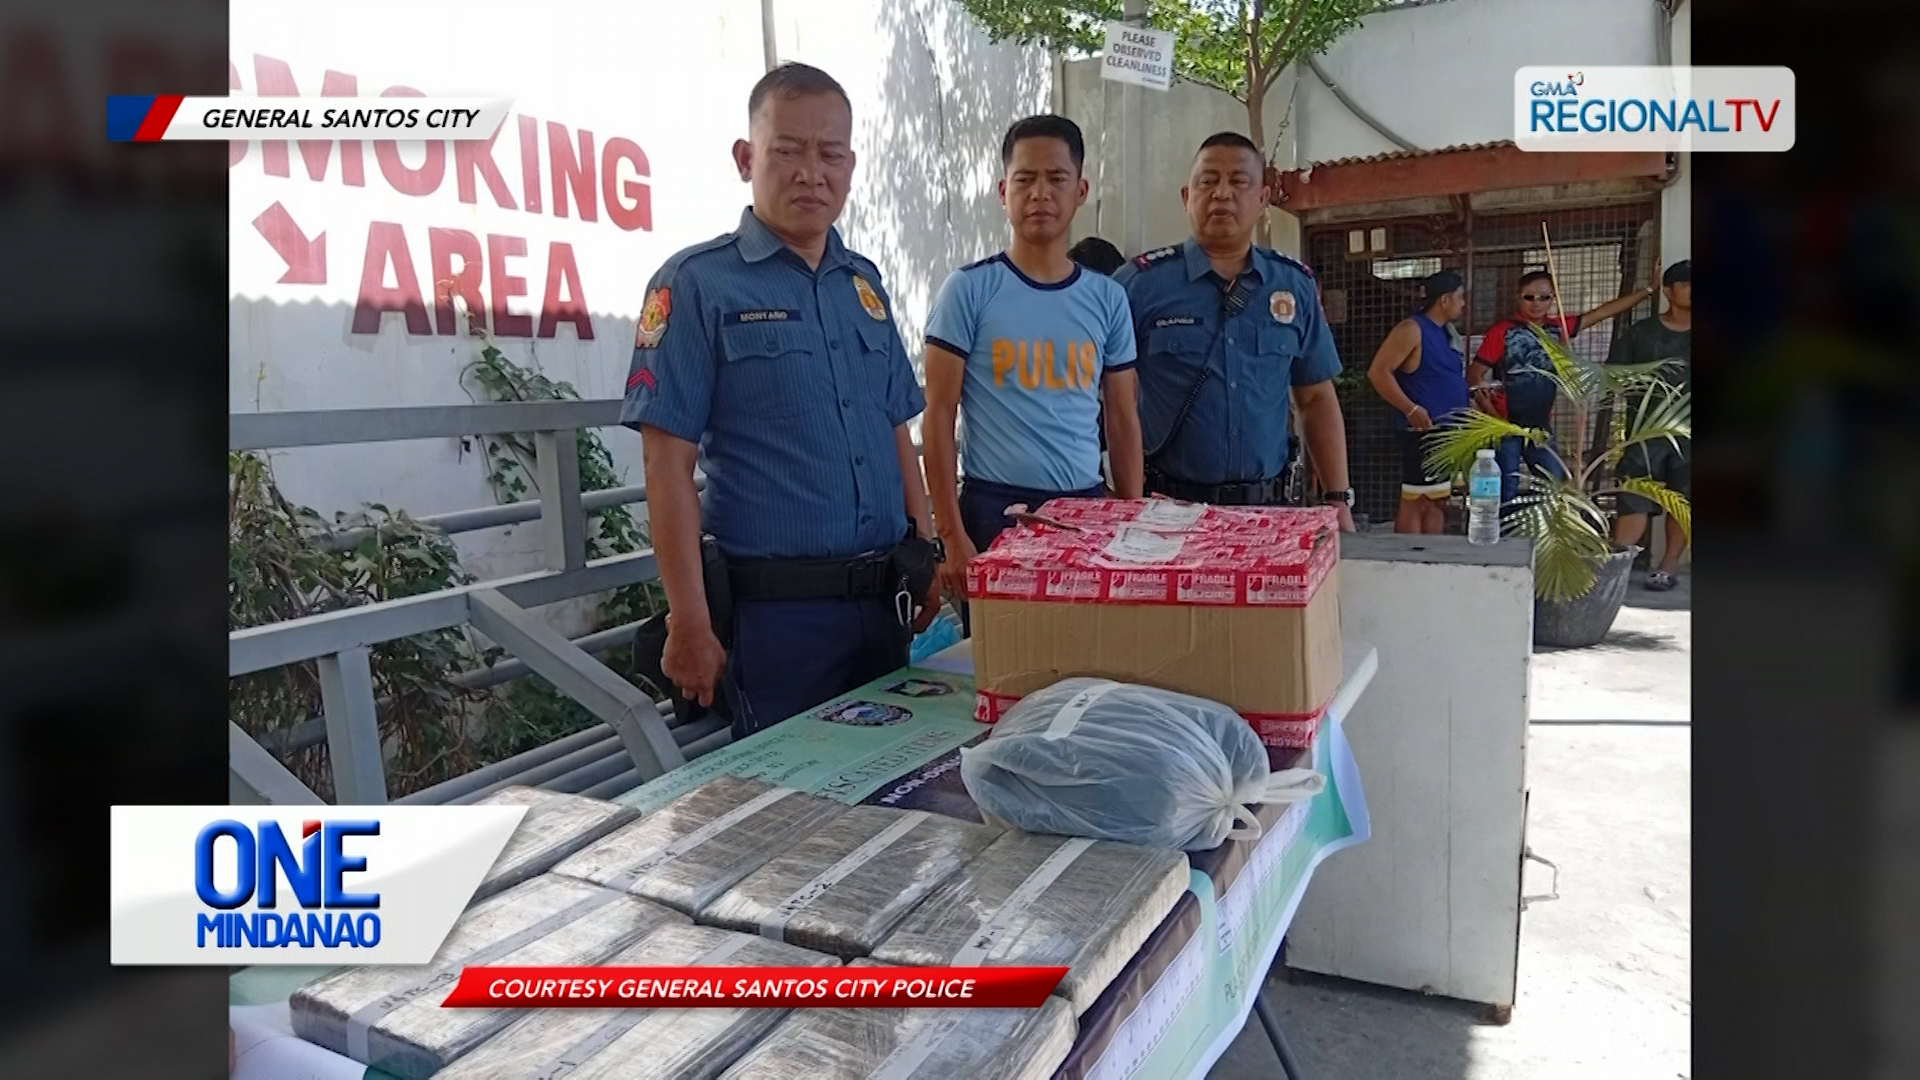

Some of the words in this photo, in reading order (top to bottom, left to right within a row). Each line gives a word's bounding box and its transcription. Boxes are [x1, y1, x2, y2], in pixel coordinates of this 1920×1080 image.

[1122, 31, 1157, 48] PLEASE
[1106, 56, 1167, 78] CLEANLINESS
[229, 54, 653, 232] MOKING
[351, 220, 595, 340] AREA
[992, 338, 1095, 391] PULIS
[1127, 573, 1168, 584] FRAGILE
[1193, 573, 1236, 585] FRAGILE
